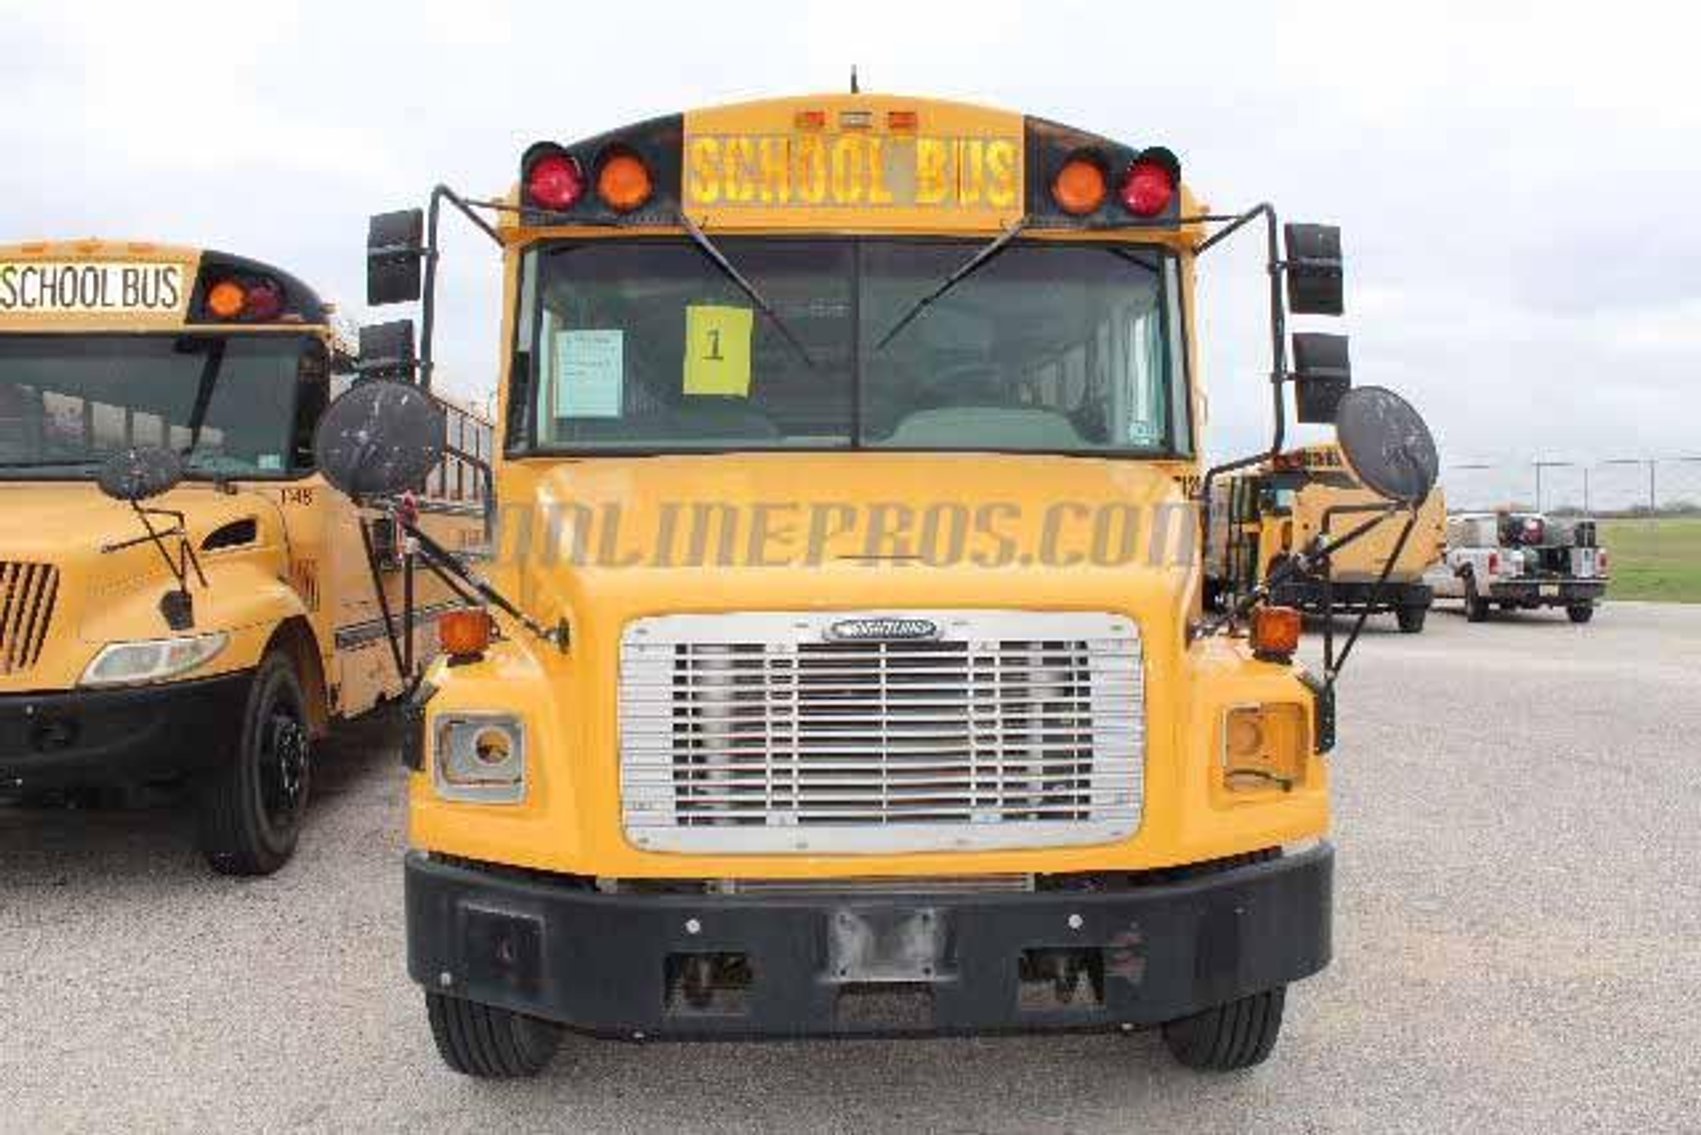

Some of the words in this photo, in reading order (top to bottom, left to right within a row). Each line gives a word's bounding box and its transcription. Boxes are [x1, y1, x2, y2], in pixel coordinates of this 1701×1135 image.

[689, 133, 892, 204] SCHOOL
[916, 134, 1016, 205] BUS
[0, 266, 115, 308] SCHOOL
[122, 267, 178, 308] BUS
[702, 329, 723, 361] 1
